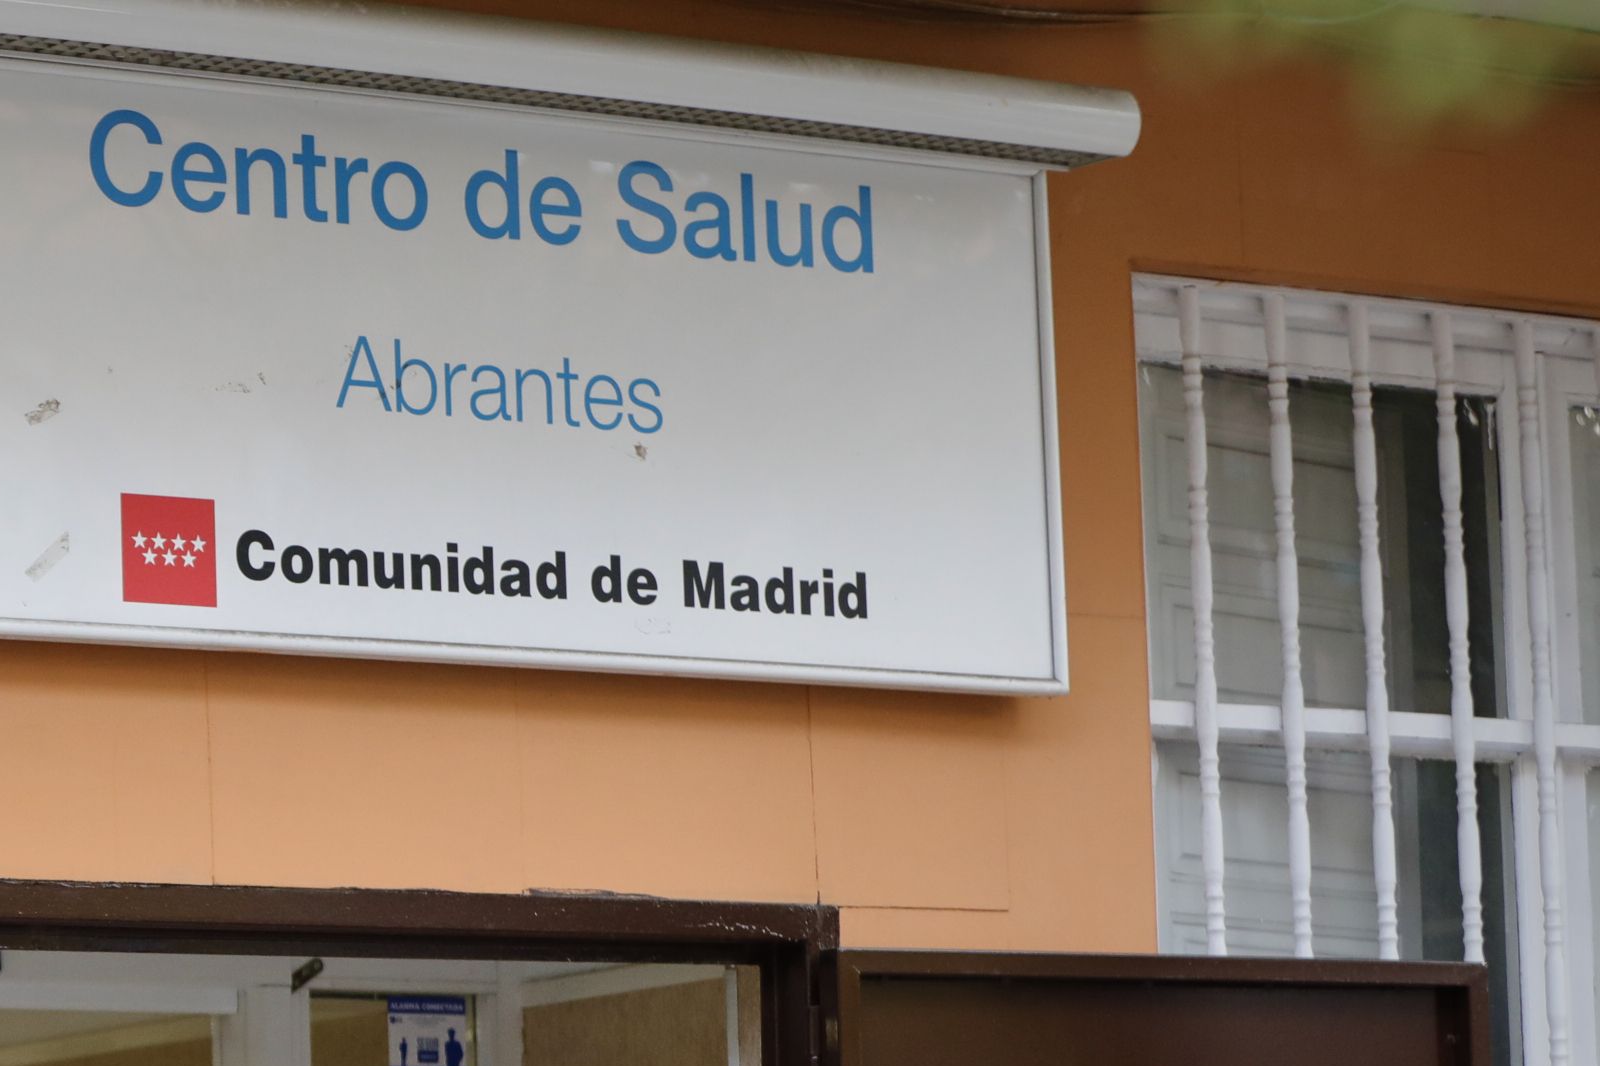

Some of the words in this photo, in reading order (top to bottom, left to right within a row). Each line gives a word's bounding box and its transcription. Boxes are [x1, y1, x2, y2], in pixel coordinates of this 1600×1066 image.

[89, 109, 428, 232] Centro
[464, 149, 583, 245] de
[617, 161, 875, 273] Salud
[336, 335, 664, 434] Abrantes
[236, 529, 568, 600] Comunidad
[591, 555, 659, 605] de
[683, 560, 868, 619] Madrid
